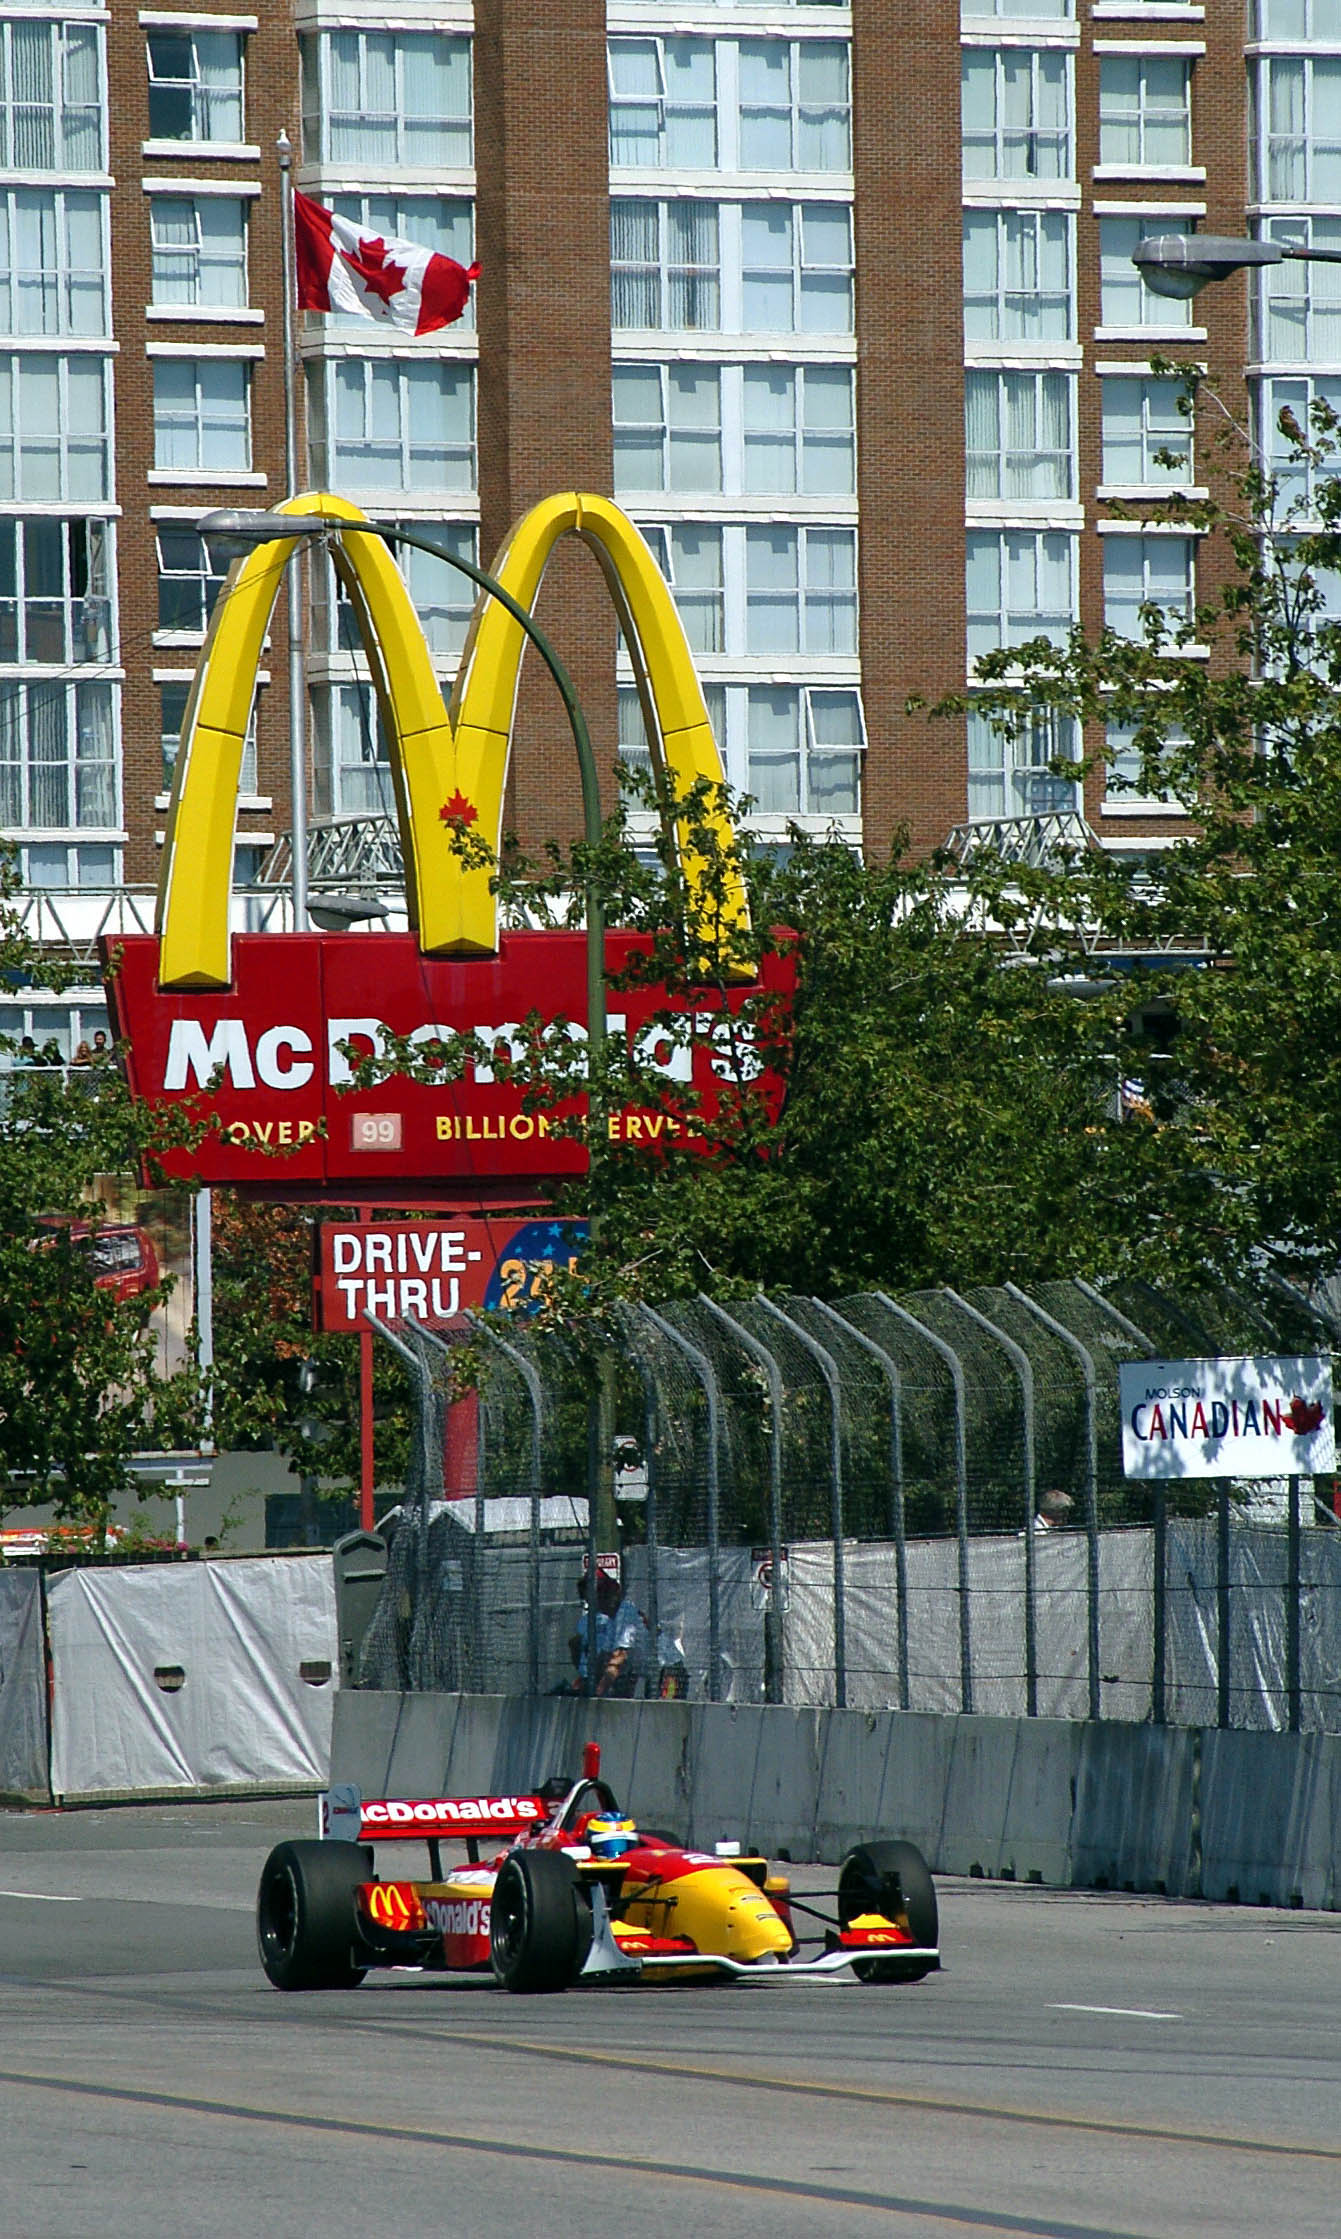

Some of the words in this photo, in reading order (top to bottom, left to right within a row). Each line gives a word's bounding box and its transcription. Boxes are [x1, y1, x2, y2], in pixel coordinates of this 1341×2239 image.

[228, 1120, 316, 1145] OVER
[361, 1120, 395, 1144] 99
[333, 1232, 482, 1274] DRIVE-
[338, 1277, 460, 1320] THRU
[1145, 1386, 1201, 1401] MOLSON
[1131, 1399, 1282, 1441] CANADIAN
